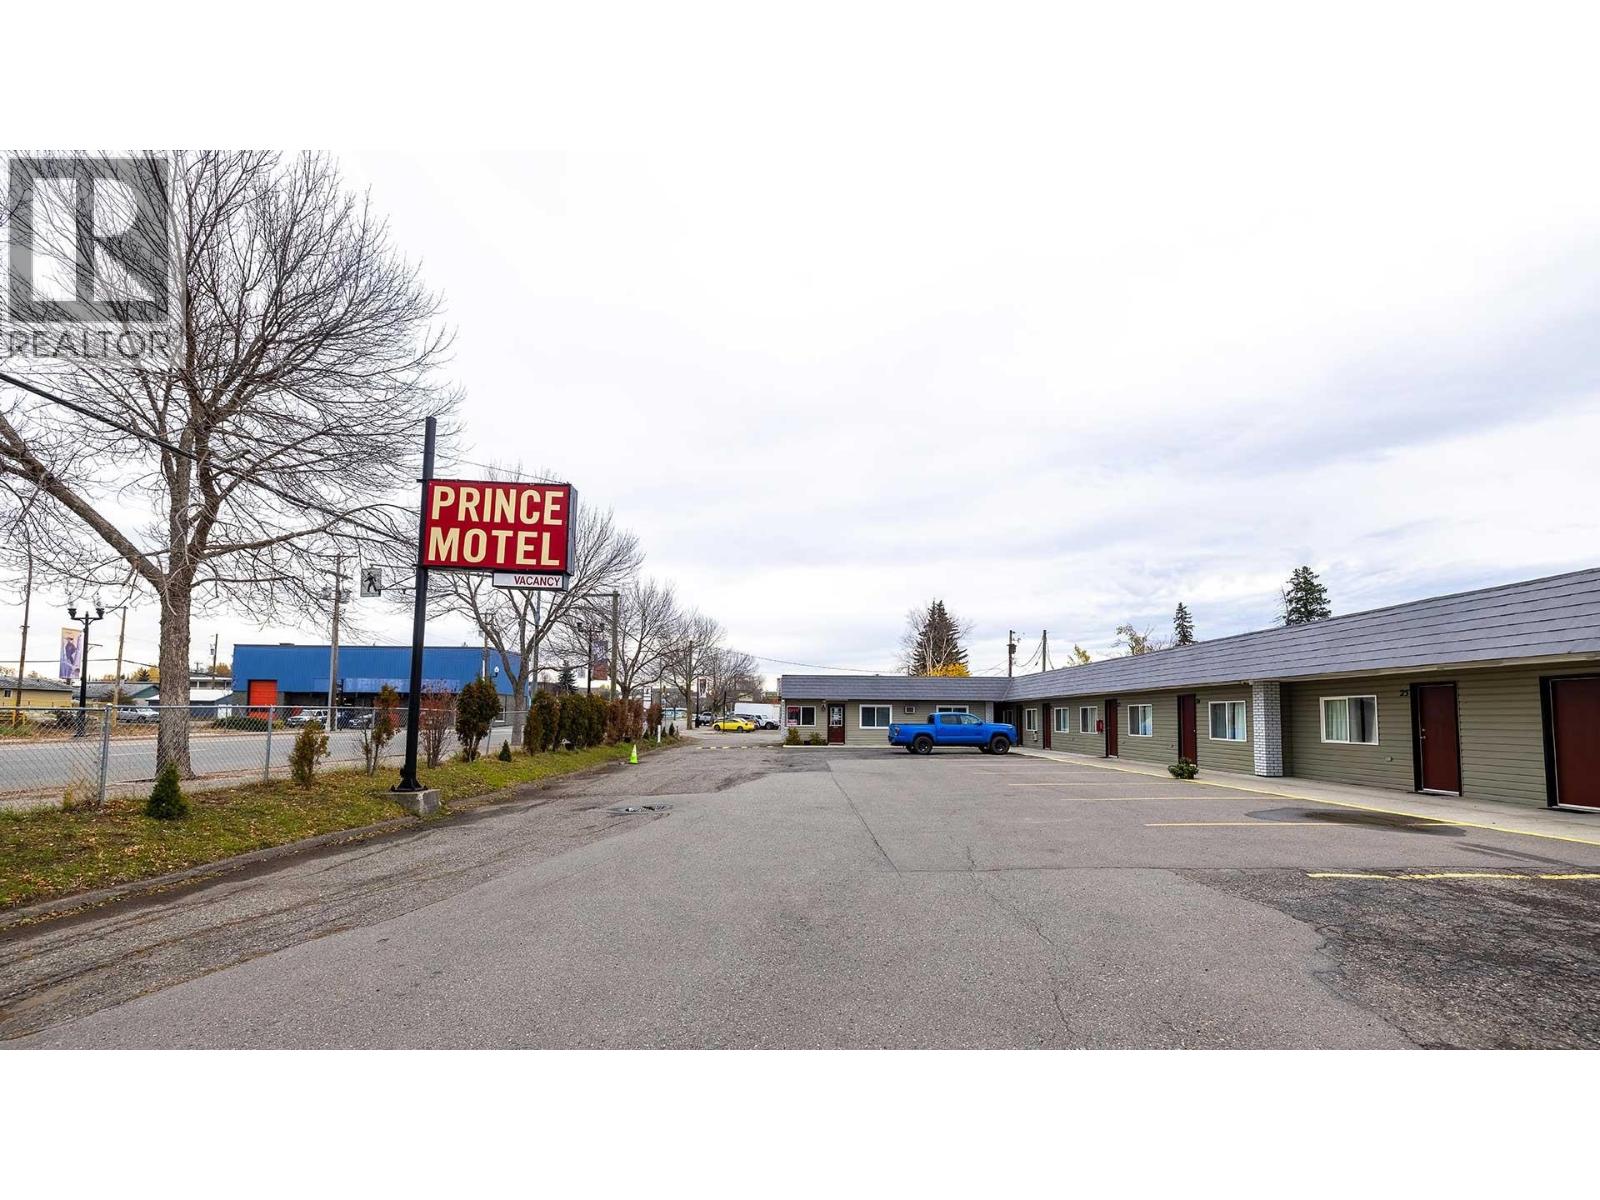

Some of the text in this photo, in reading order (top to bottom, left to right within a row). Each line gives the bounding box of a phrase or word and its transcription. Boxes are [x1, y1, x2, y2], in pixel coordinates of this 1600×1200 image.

[431, 485, 564, 526] PRINCE
[427, 526, 560, 566] MOTEL
[514, 575, 561, 586] VACANCY
